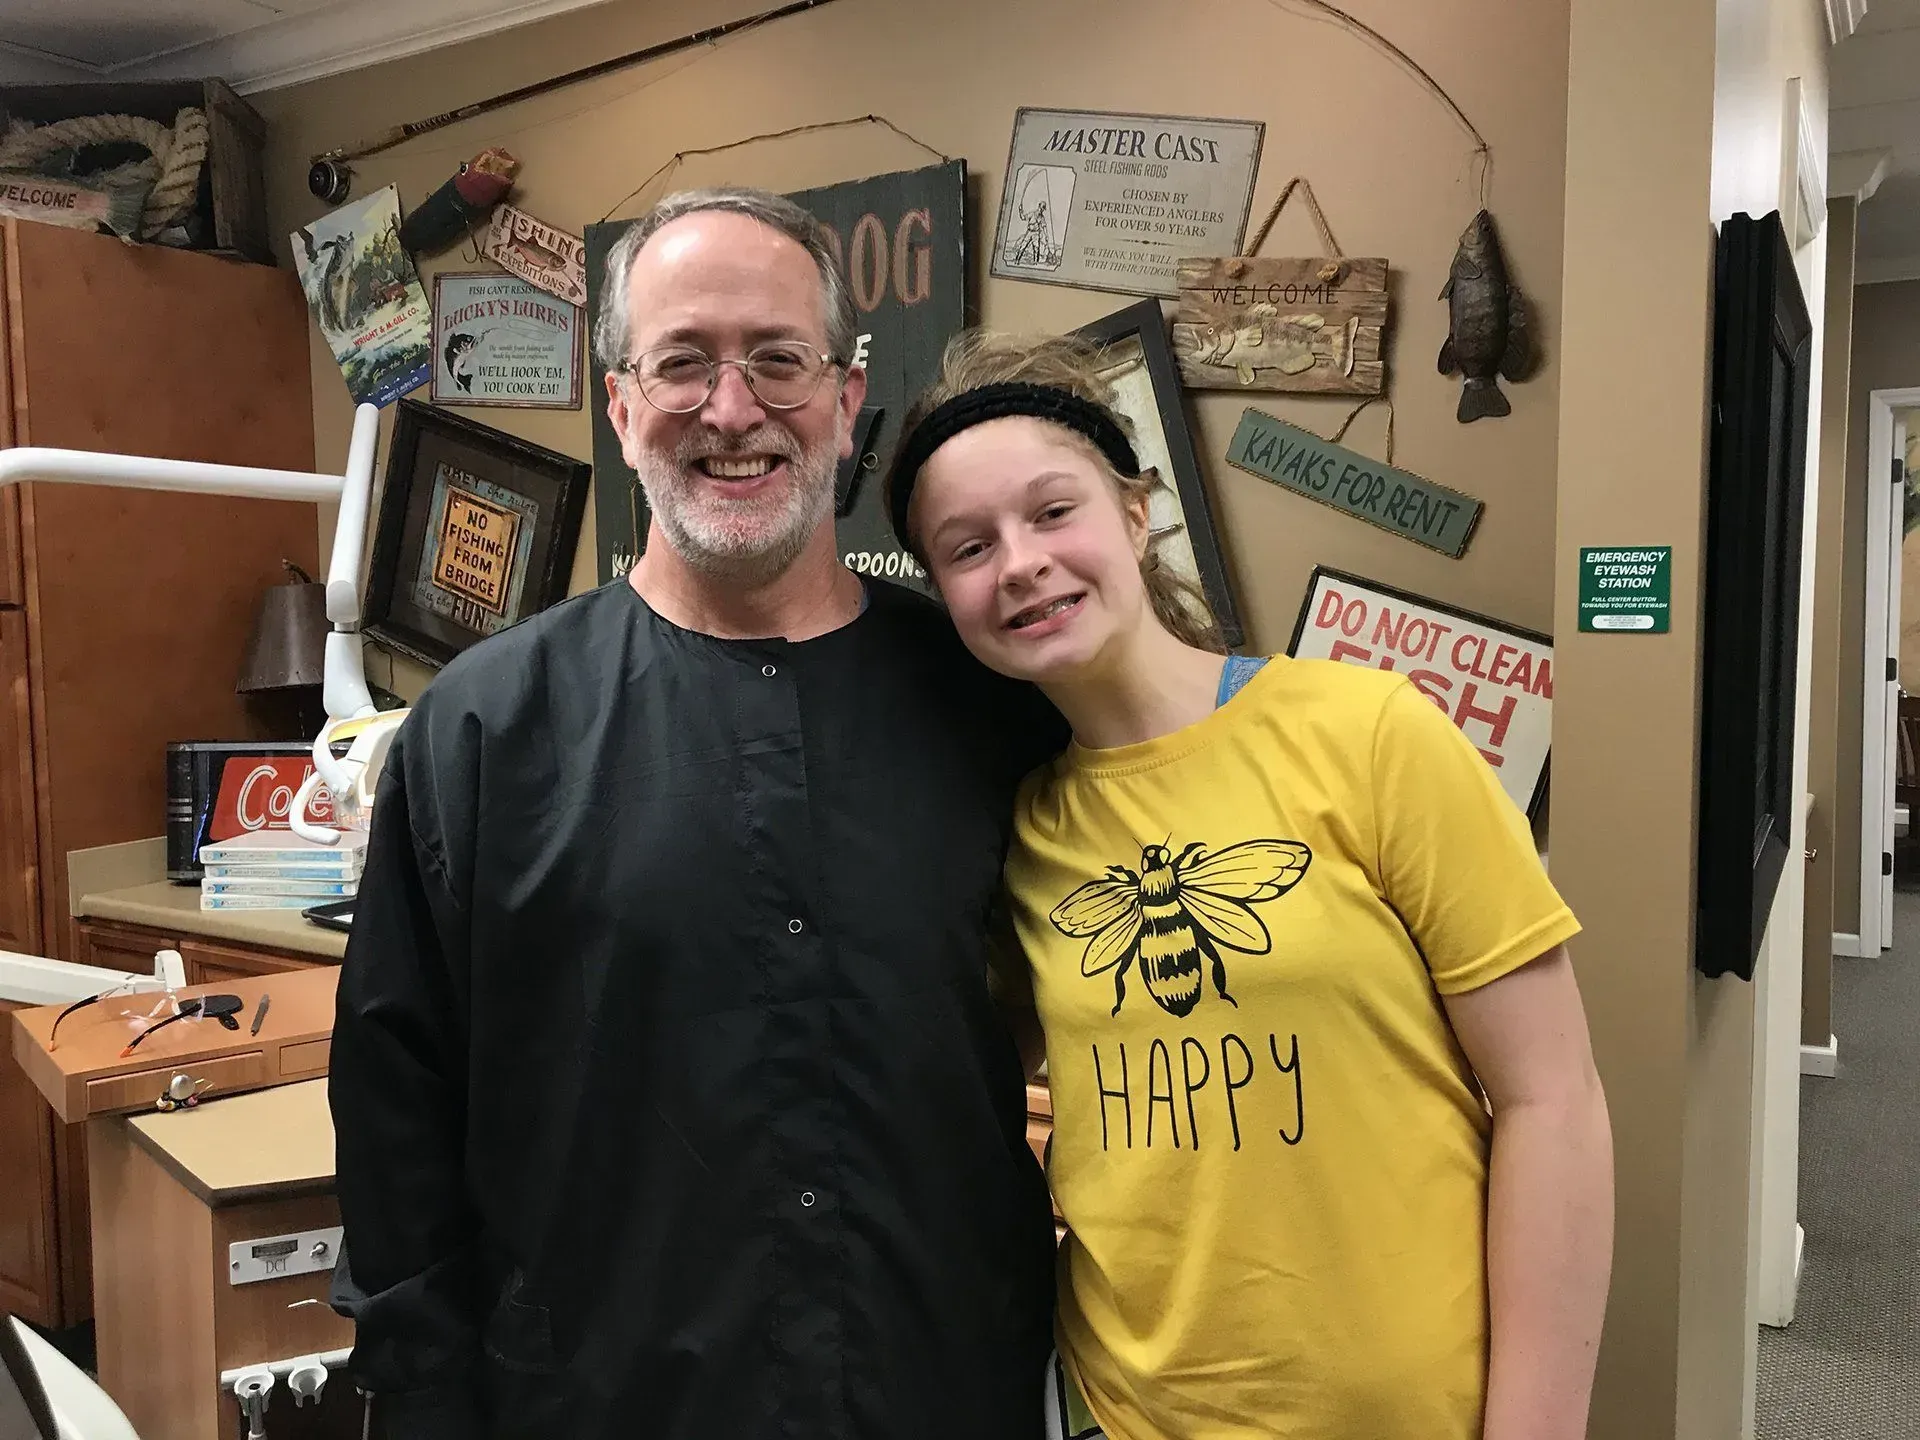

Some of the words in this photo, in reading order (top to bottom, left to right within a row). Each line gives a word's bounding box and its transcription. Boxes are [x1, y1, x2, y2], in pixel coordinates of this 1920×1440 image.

[1043, 128, 1147, 158] MASTER
[1154, 132, 1221, 164] CAST
[1084, 159, 1107, 174] STEEL
[1109, 160, 1142, 177] FISHING
[1143, 164, 1168, 179] RODS
[1122, 188, 1171, 203] CHOSEN
[1172, 192, 1189, 205] BY
[1084, 200, 1165, 218] EXPERIENCED
[1166, 208, 1225, 224] ANGLERS
[1095, 216, 1118, 229] FOR
[1120, 219, 1151, 232] OVER
[1153, 222, 1166, 233] 50
[1168, 223, 1207, 238] YEARS
[1084, 259, 1107, 270] WITH
[1109, 260, 1138, 273] THEIR
[1098, 248, 1126, 260] THINK
[1127, 251, 1149, 262] YOU
[1149, 253, 1172, 266] WILL
[500, 250, 566, 292] EXPEDITIONS
[468, 286, 486, 295] FISH
[1211, 283, 1340, 305] WELCOME
[443, 299, 510, 332] LUCKY'S
[513, 299, 568, 332] LURES
[352, 328, 378, 347] WRIGHT
[378, 325, 386, 334] &
[478, 365, 508, 378] WE'LL
[511, 366, 541, 379] HOOK
[483, 381, 504, 393] YOU
[506, 382, 538, 394] COOK
[537, 381, 560, 395] 'EM!
[1241, 427, 1336, 492] KAYAKS
[1332, 463, 1386, 513] FOR
[1383, 483, 1459, 537] RENT
[466, 509, 488, 530] NO
[449, 523, 505, 558] FISHING
[453, 547, 492, 574] FROM
[1585, 551, 1667, 563] EMERGENCY
[445, 563, 495, 598] BRIDGE
[1594, 565, 1657, 576] EYEWASH
[1598, 578, 1652, 589] STATION
[452, 596, 487, 631] FUN
[1314, 589, 1368, 637] DO
[1371, 607, 1452, 663] NOT
[237, 764, 334, 831] Coe
[1092, 1033, 1304, 1152] HAPPY
[265, 1259, 287, 1274] DCI
